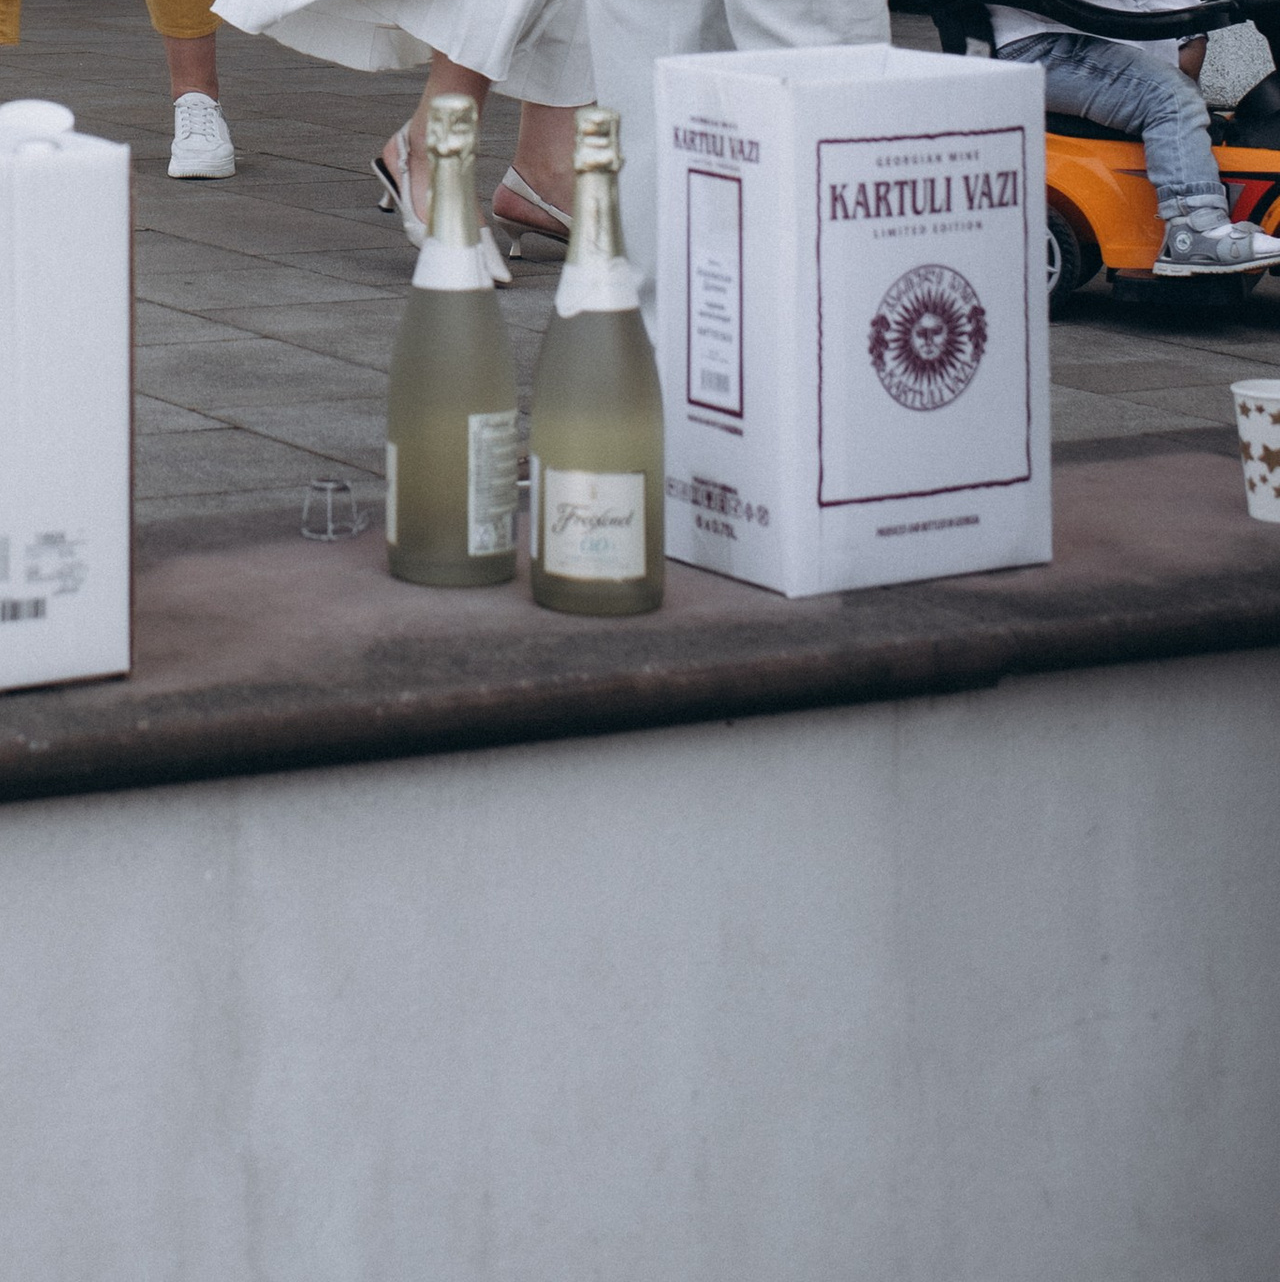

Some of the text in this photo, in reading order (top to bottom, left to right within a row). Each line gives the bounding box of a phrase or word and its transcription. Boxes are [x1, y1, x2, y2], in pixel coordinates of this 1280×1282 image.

[674, 126, 760, 163] KARTULI VAZI
[875, 153, 943, 168] GEORGIAN
[829, 170, 1019, 221] KARTULI VAZI
[873, 220, 983, 239] LIMITED EDITION
